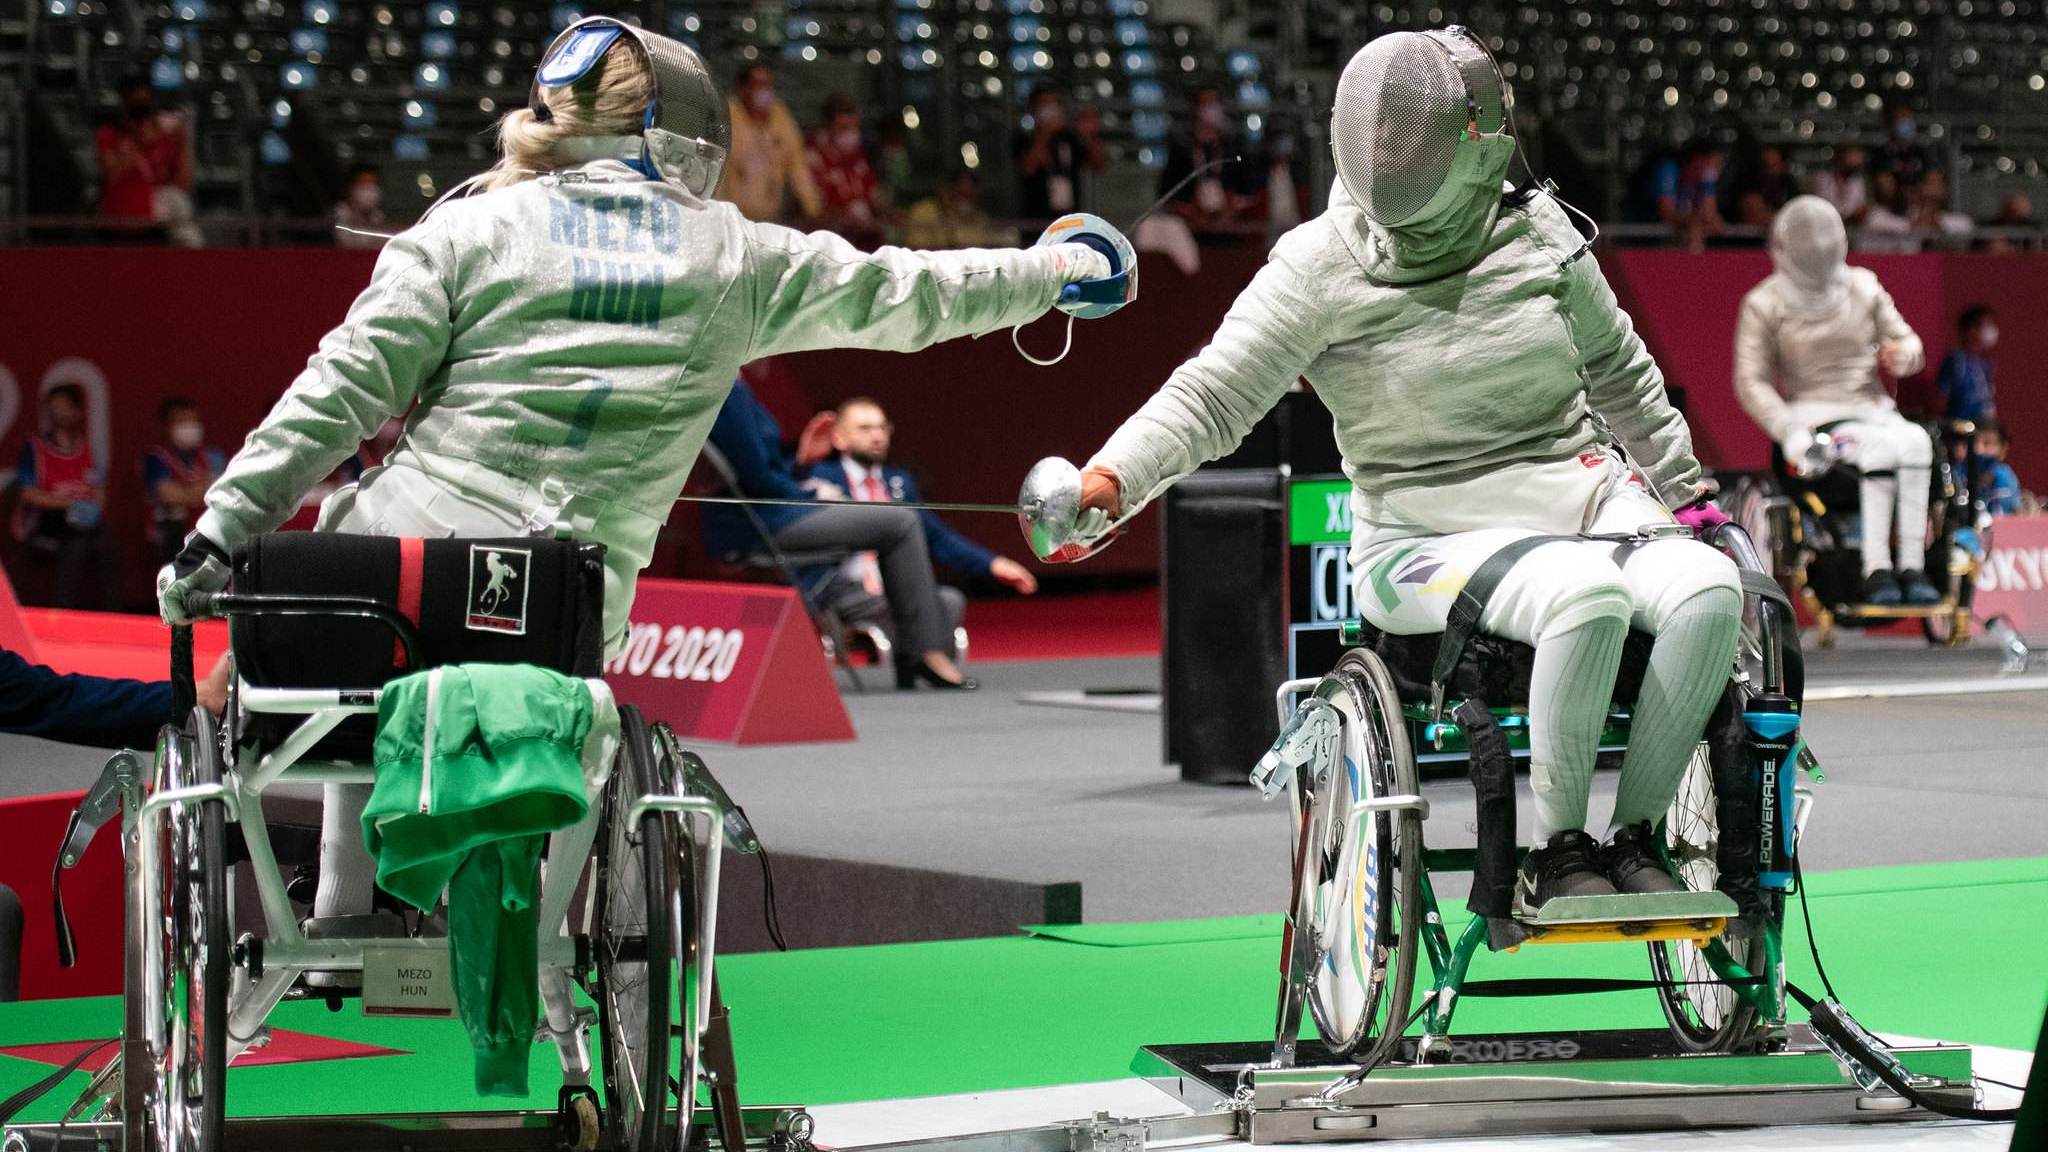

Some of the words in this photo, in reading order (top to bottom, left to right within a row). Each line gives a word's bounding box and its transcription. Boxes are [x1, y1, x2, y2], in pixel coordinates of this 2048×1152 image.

[549, 194, 681, 254] MEZO
[569, 256, 664, 330] HUN
[650, 624, 744, 682] 2020
[397, 969, 432, 980] MEZO
[400, 985, 428, 996] HUN
